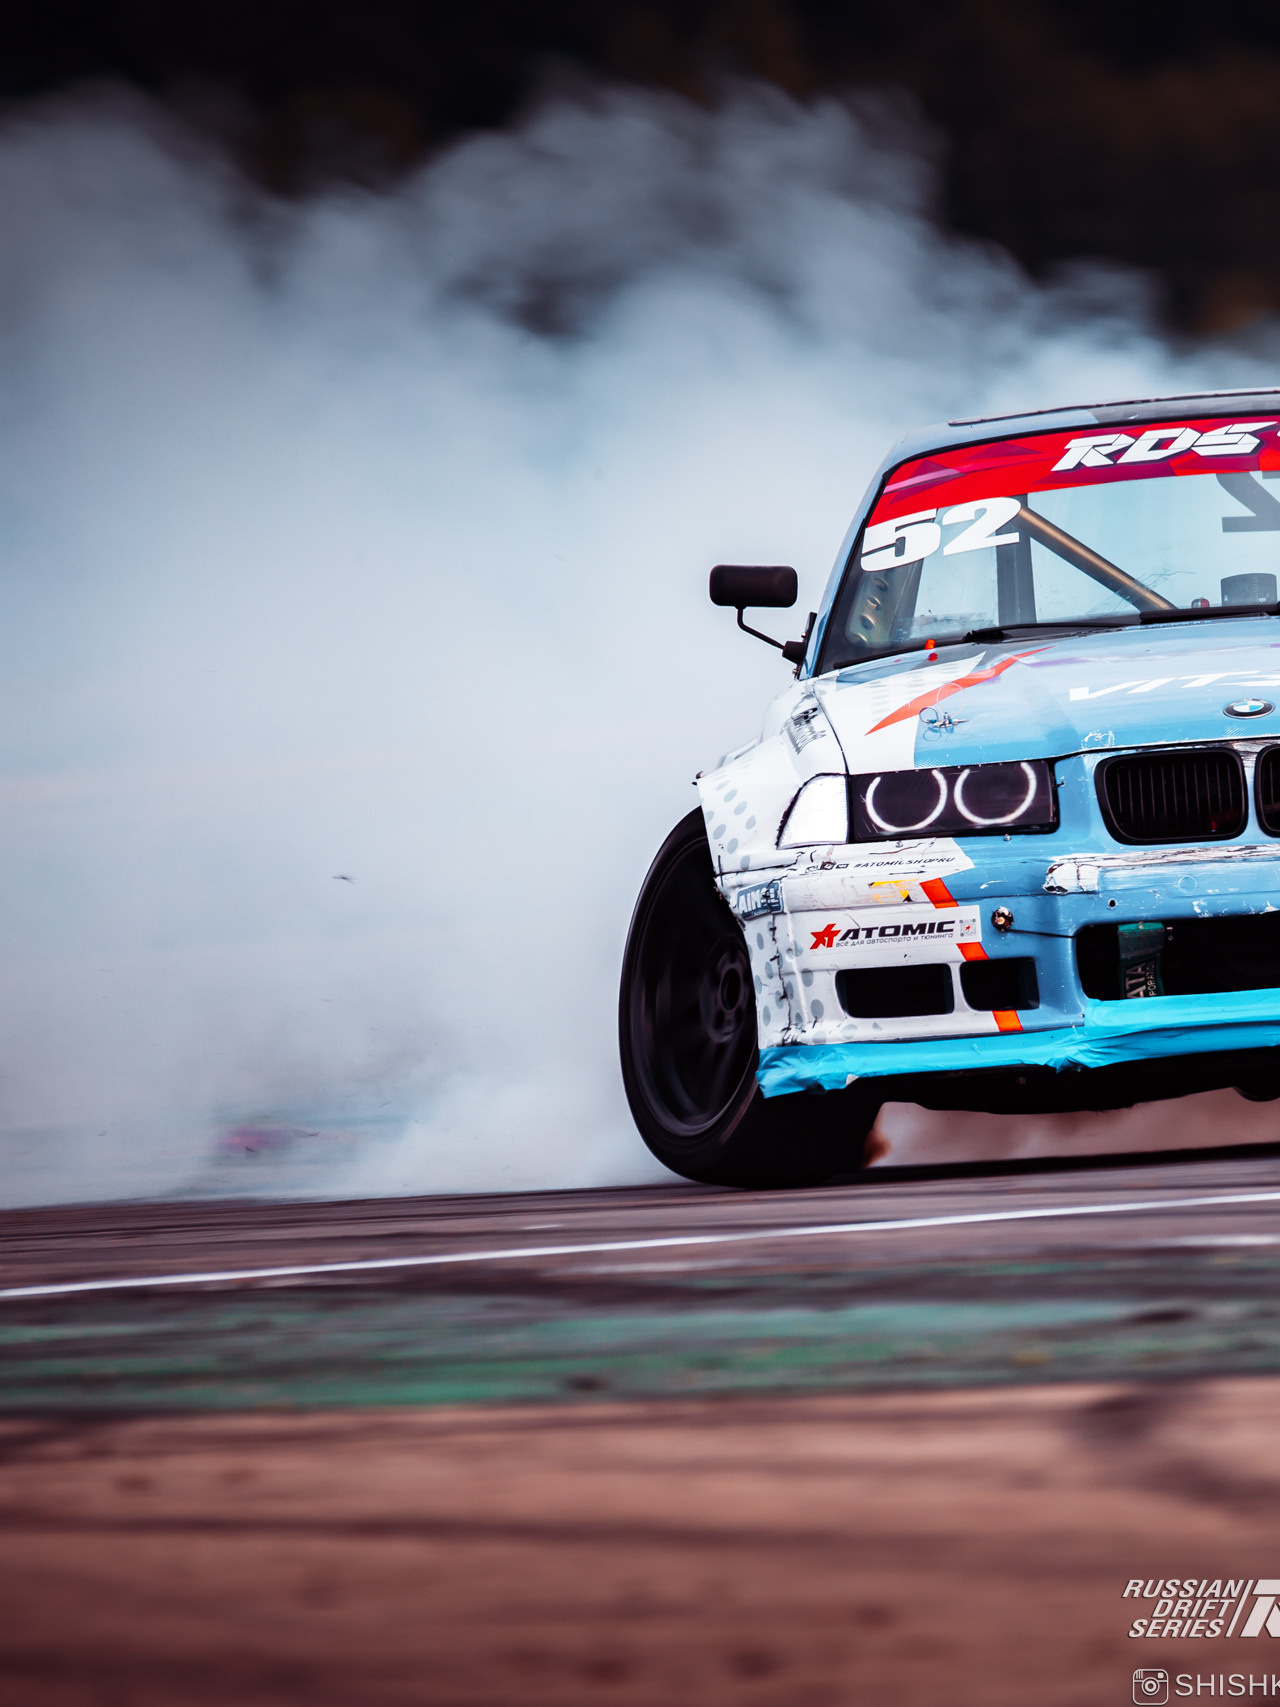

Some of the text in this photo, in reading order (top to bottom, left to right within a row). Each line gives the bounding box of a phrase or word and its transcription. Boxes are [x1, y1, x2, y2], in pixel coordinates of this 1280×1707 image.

[1050, 421, 1278, 472] RDS
[860, 496, 1022, 572] 52
[839, 920, 956, 942] ATOMIC
